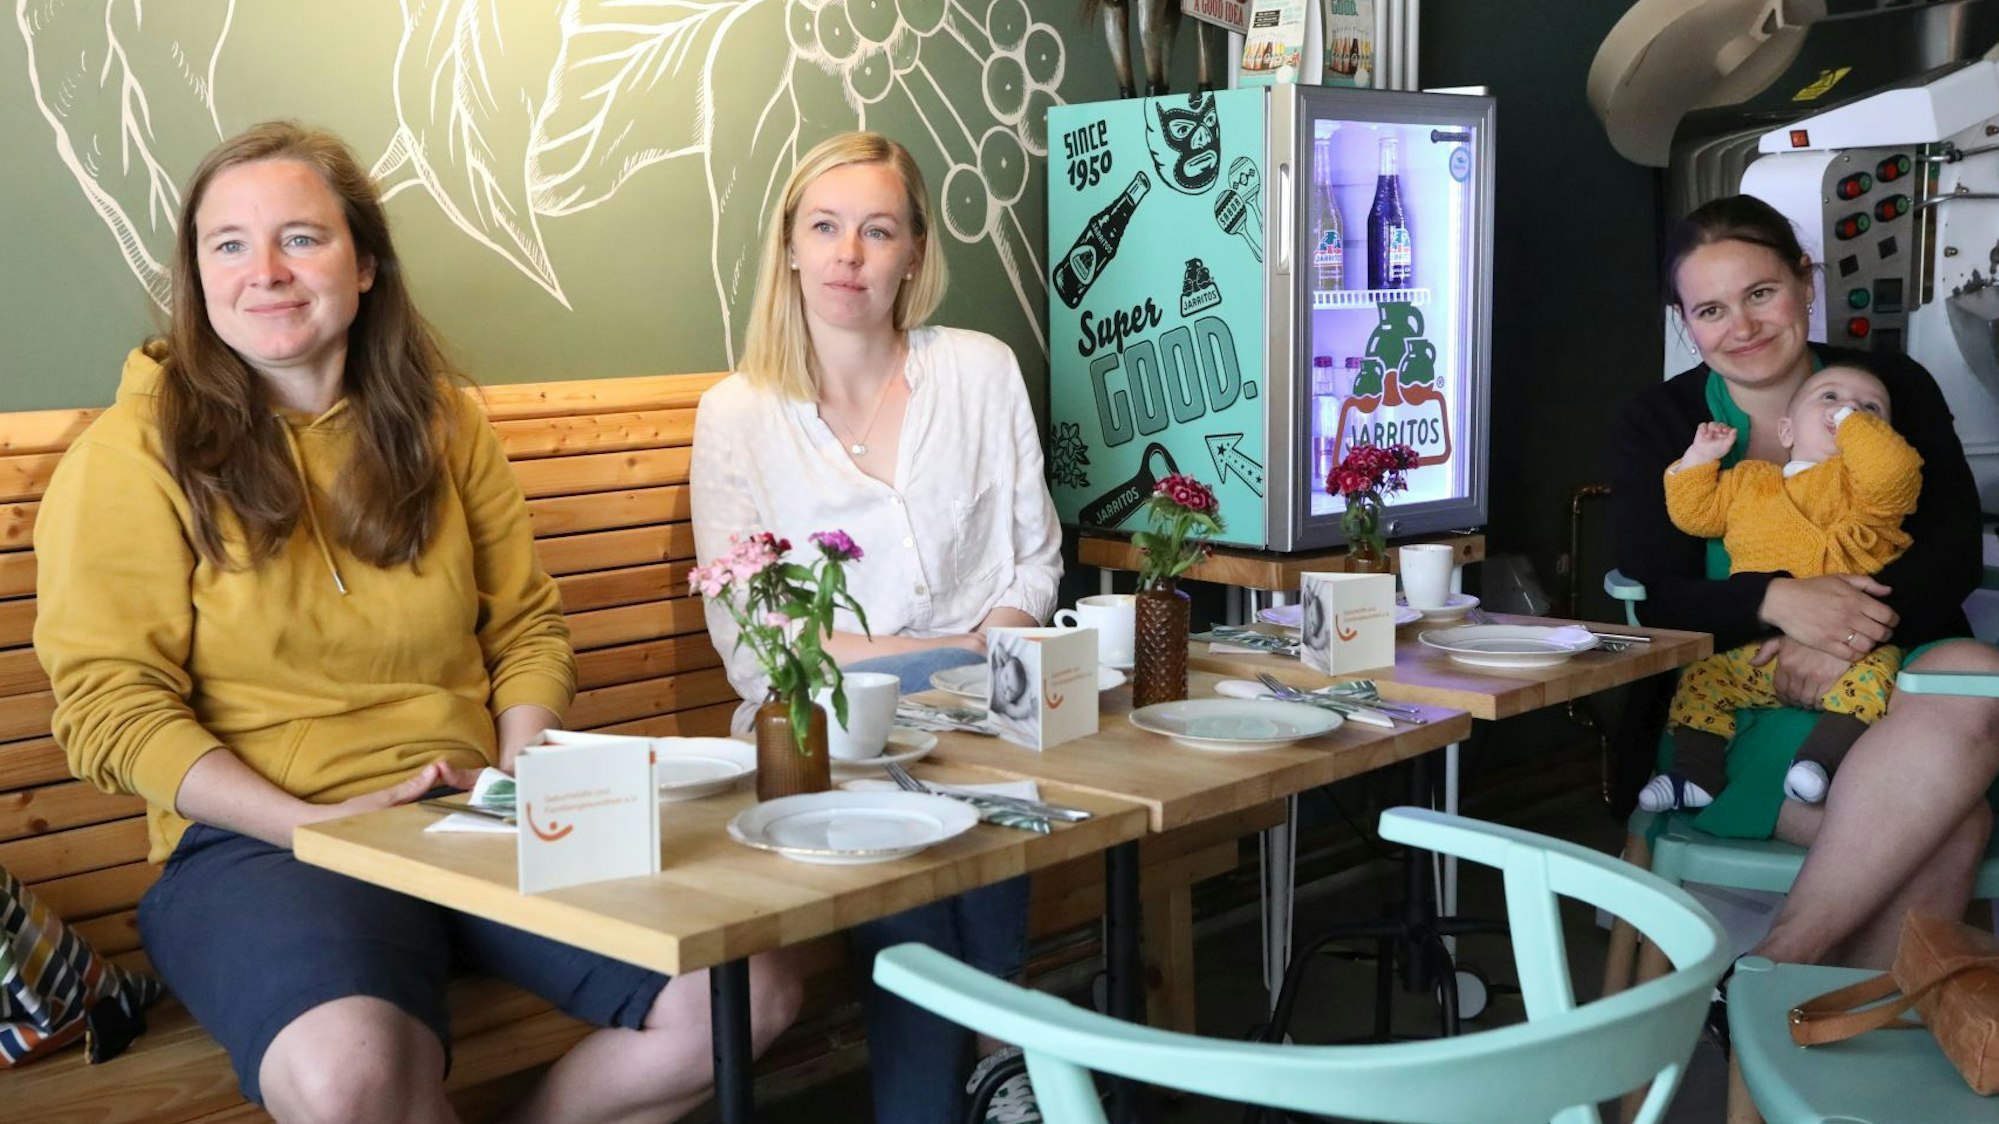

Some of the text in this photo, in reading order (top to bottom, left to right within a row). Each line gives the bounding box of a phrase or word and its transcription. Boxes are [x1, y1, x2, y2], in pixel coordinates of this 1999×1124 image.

[1202, 0, 1224, 19] GOOD
[1225, 0, 1243, 26] IDEA
[1063, 119, 1109, 160] SINCE
[1067, 150, 1113, 191] 1950
[1219, 197, 1242, 226] SABOR
[1183, 290, 1217, 311] JARRITOS
[1078, 297, 1163, 357] Super
[1090, 316, 1258, 448] GOOD.
[1345, 418, 1440, 451] JARRITOS
[1096, 486, 1140, 525] JARRITOS
